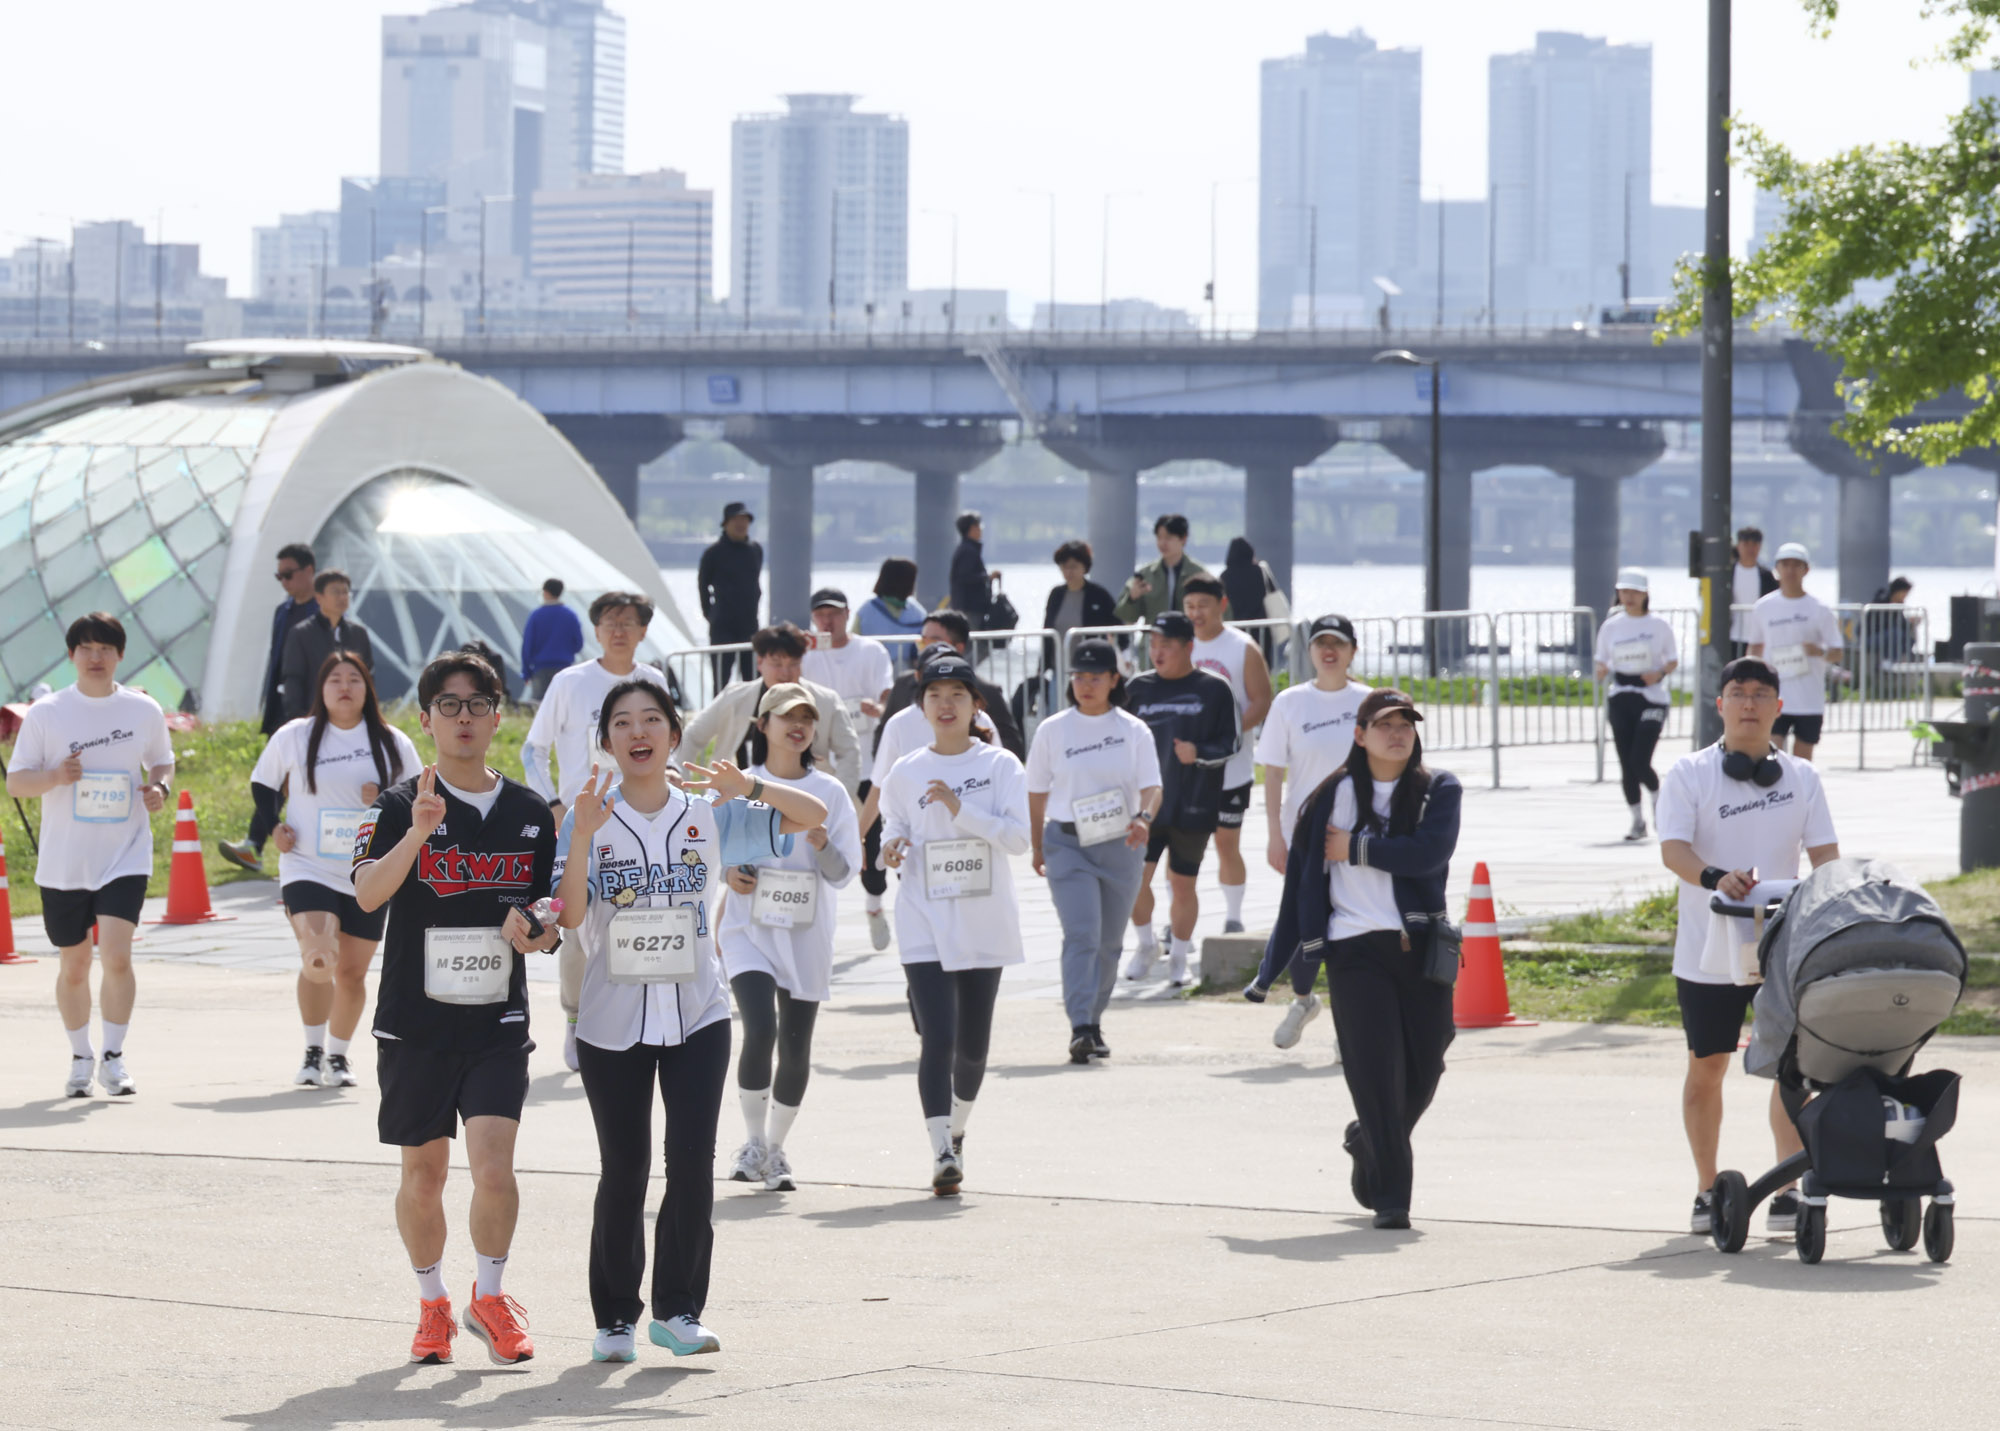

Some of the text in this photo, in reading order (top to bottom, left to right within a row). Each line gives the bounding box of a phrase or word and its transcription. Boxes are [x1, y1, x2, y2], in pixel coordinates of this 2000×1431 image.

[69, 729, 134, 754] Burning Run
[963, 777, 991, 792] Run
[92, 790, 127, 802] 7195
[1718, 790, 1794, 819] Burning Run
[600, 858, 637, 869] DOOSAN
[931, 858, 983, 873] W 6086
[600, 863, 708, 901] BEARS
[761, 889, 810, 904] W 6085
[617, 934, 686, 951] W 6273
[436, 955, 502, 971] M 5206
